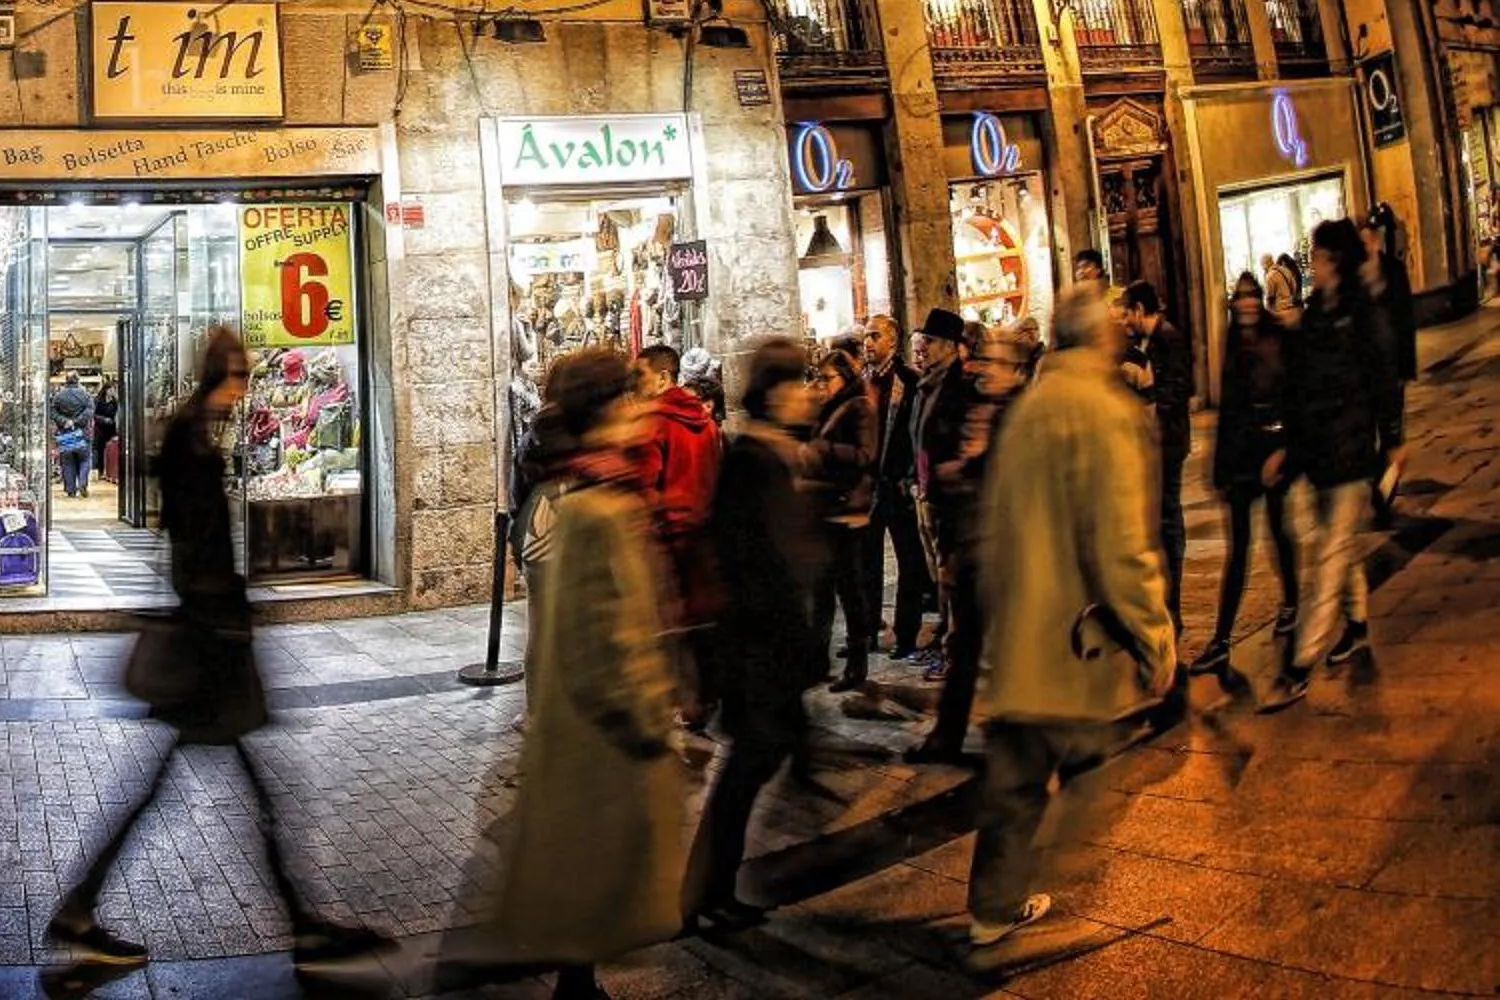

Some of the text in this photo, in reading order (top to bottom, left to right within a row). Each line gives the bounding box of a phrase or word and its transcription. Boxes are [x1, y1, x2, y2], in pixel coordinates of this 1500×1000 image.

[162, 83, 186, 96] this
[216, 83, 228, 95] is
[231, 83, 265, 95] mine
[2, 145, 45, 165] Bag
[62, 137, 145, 172] Bolsetta
[132, 146, 189, 177] Hand
[190, 129, 258, 159] Tasche
[263, 138, 317, 163] Bolso
[243, 206, 347, 229] OFERTA
[245, 221, 348, 251] OFFRE SUPPLY
